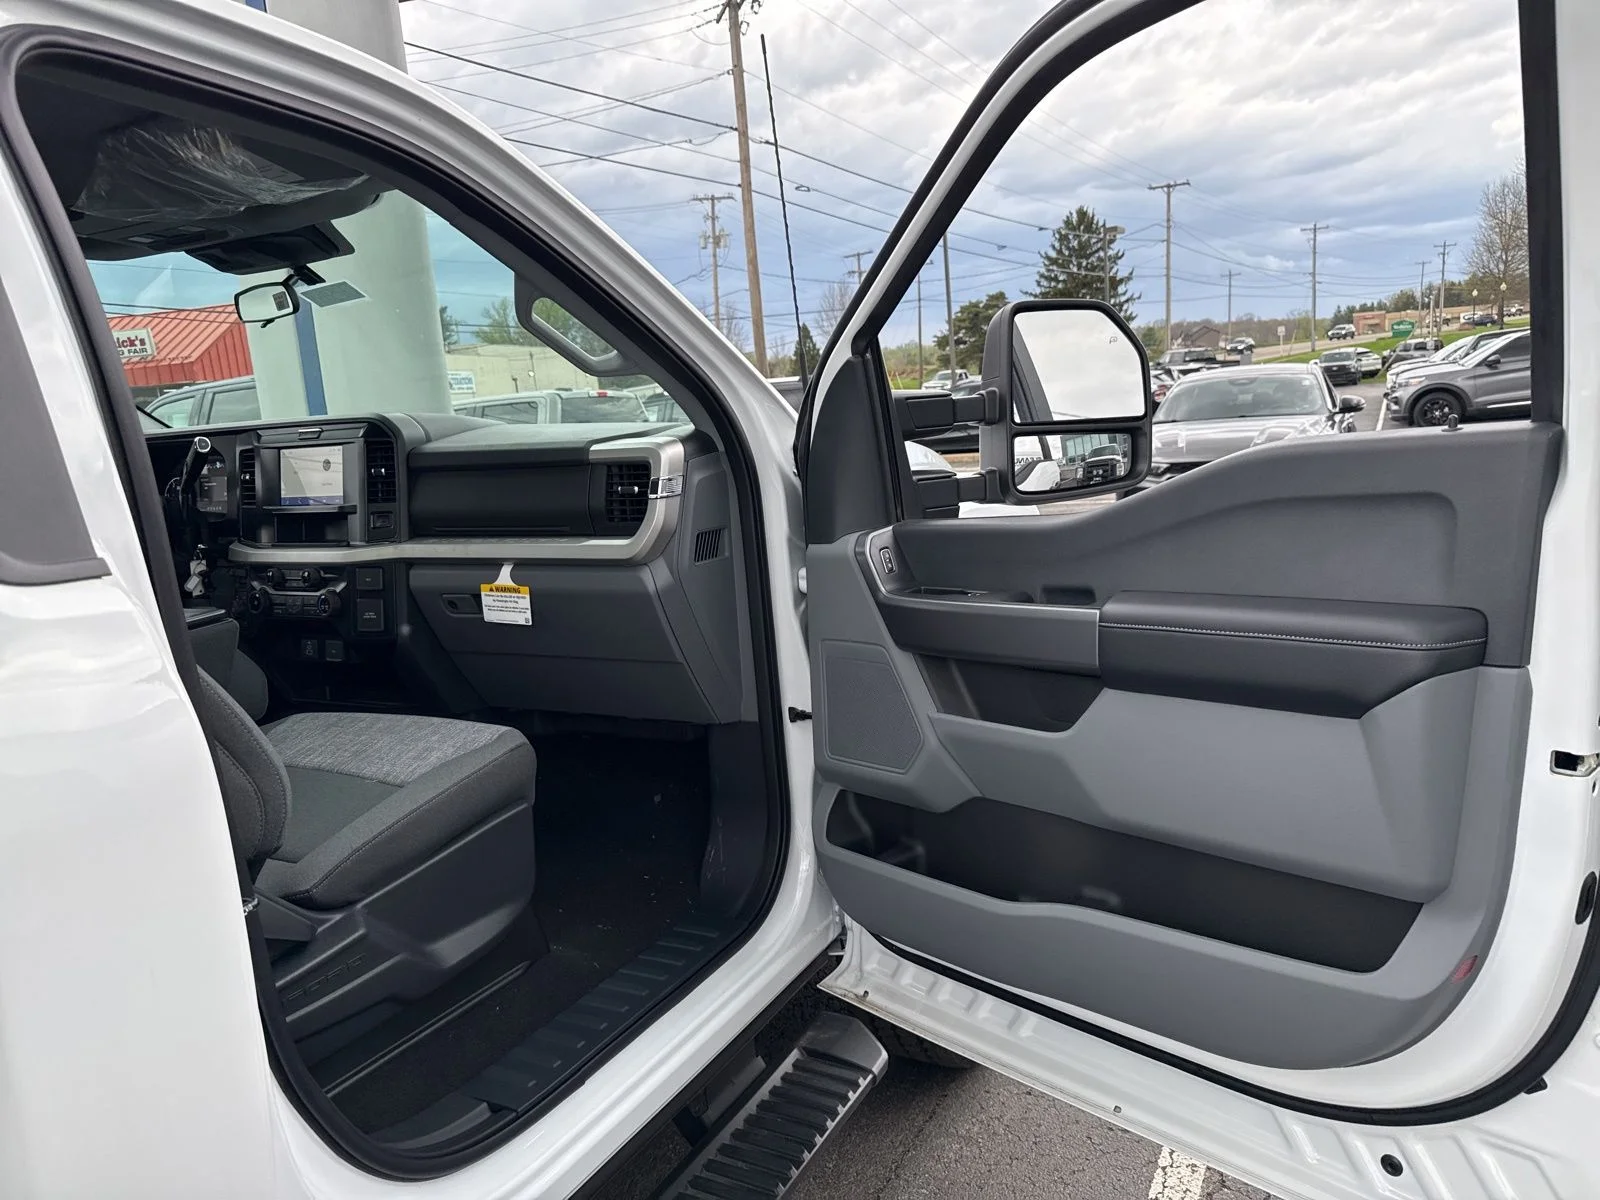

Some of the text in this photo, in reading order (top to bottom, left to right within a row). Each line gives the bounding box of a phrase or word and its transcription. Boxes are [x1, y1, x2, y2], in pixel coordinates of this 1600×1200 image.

[116, 336, 146, 348] ick's
[127, 347, 148, 355] FAIR
[495, 586, 521, 594] WARNING
